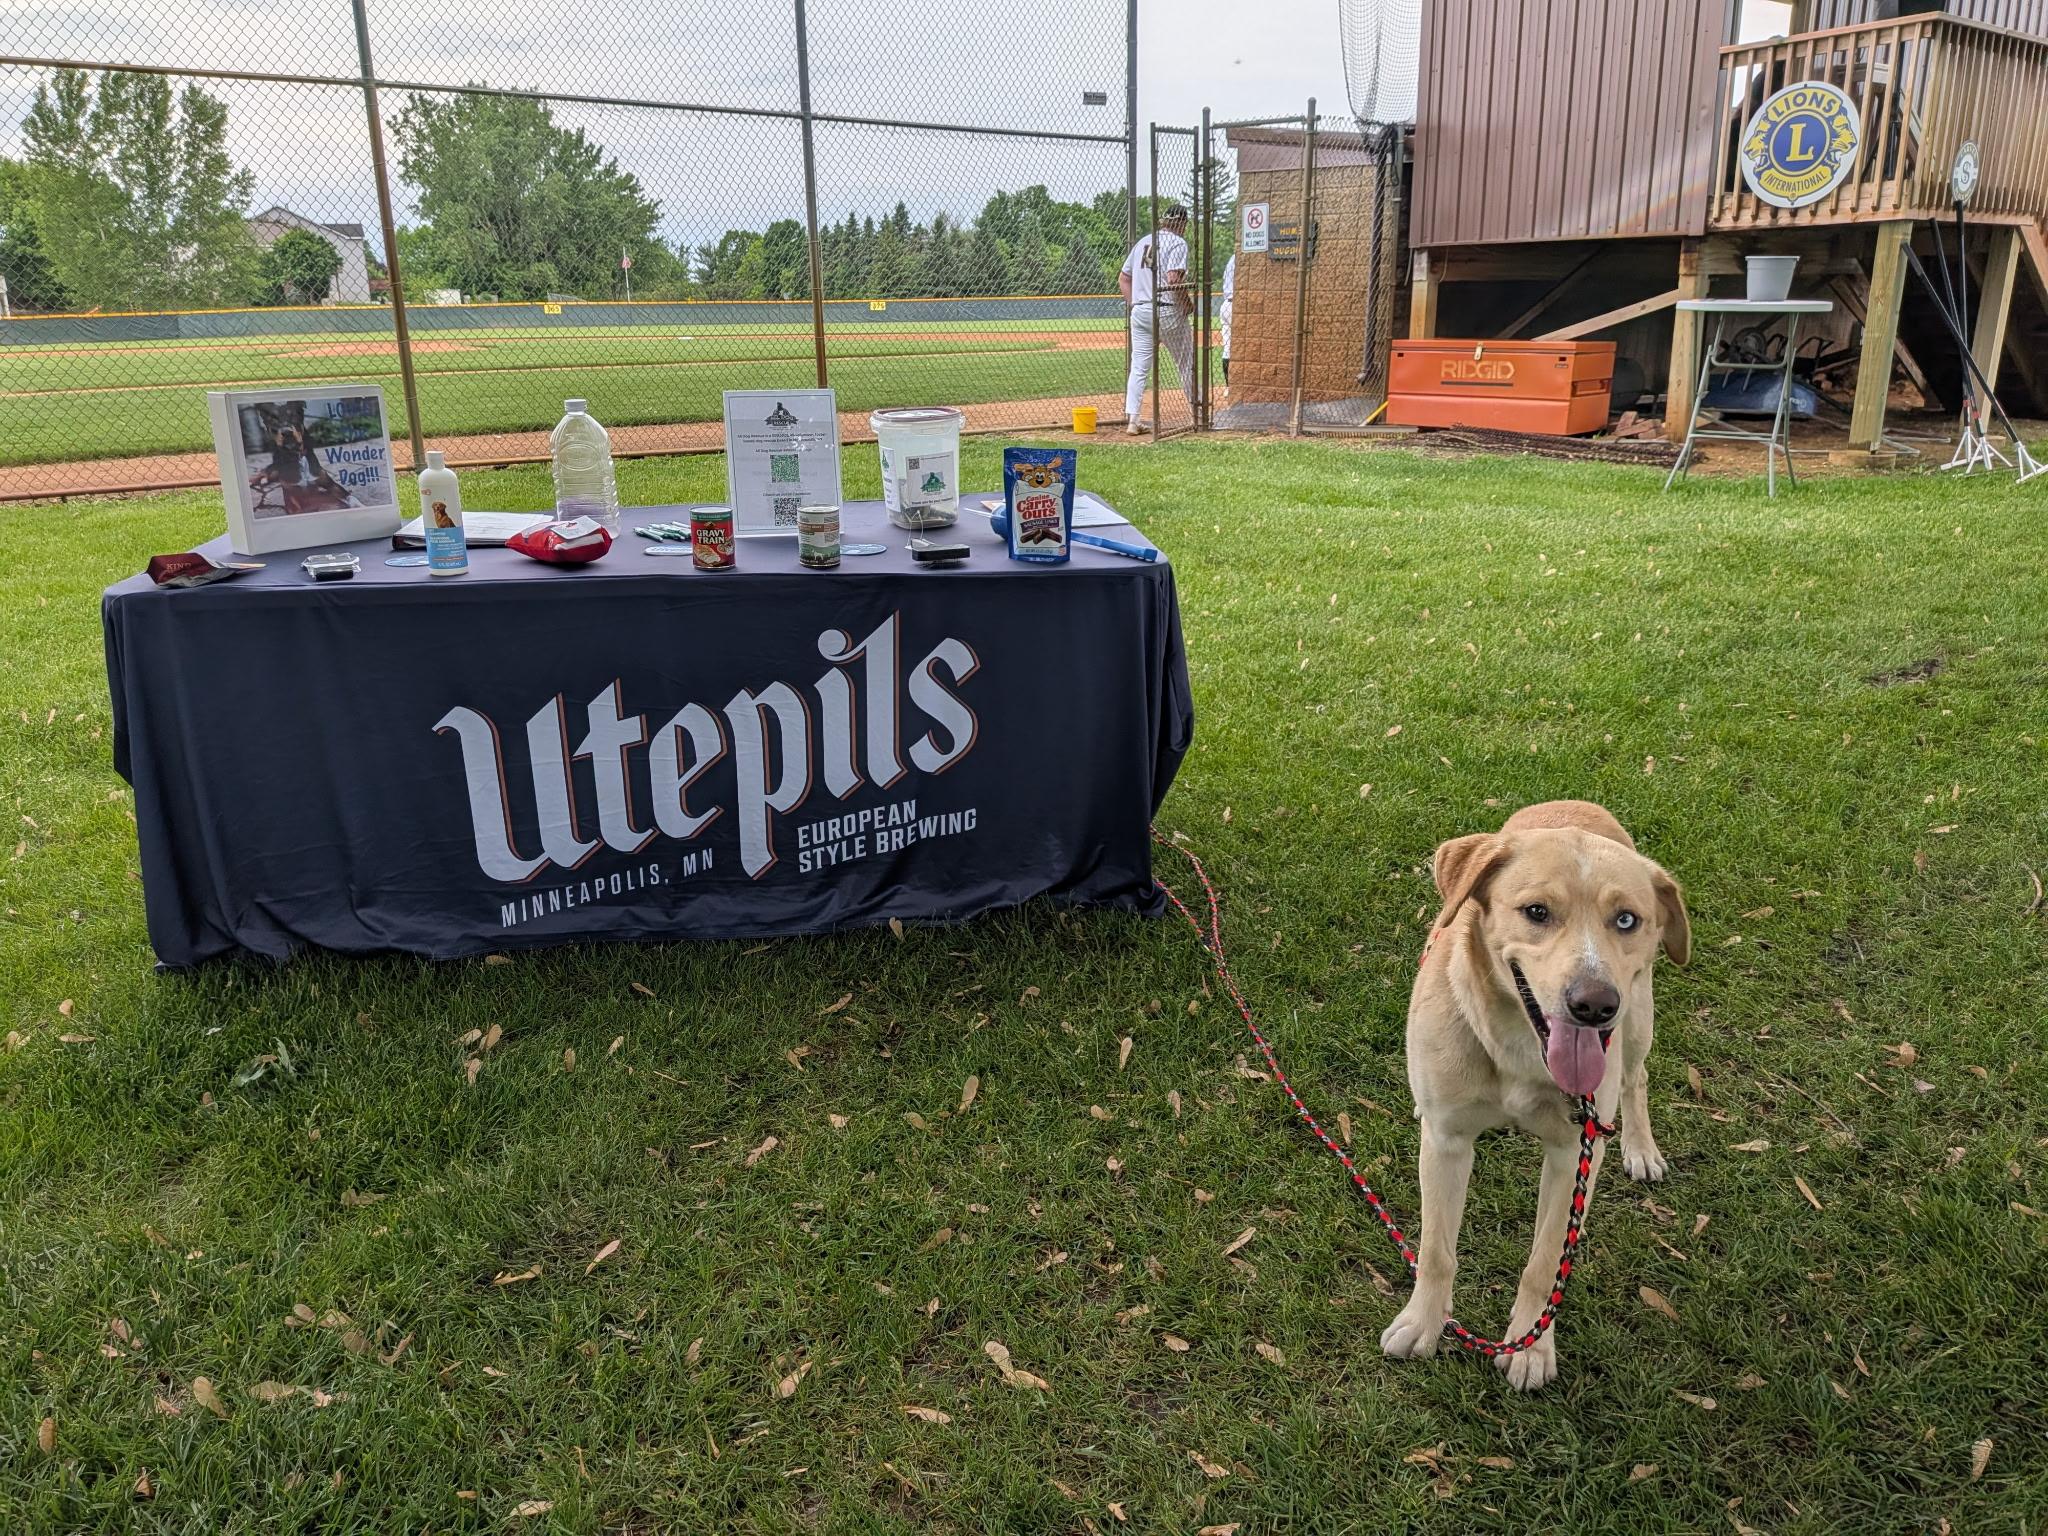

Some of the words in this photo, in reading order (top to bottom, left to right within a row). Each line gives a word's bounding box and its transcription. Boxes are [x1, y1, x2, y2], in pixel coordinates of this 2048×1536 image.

[1771, 91, 1837, 118] LIONS
[1785, 123, 1814, 162] L
[1763, 171, 1828, 193] INTERNATIONAL
[1960, 160, 1972, 184] S
[1245, 239, 1265, 248] ALLOWED
[1252, 230, 1265, 238] DOGS
[1440, 359, 1515, 380] RIDGID
[325, 445, 385, 465] Wonder
[338, 466, 380, 487] Dog!!!
[1016, 498, 1057, 513] Carry
[1025, 494, 1050, 502] Canine
[696, 529, 725, 537] GRAVY
[697, 536, 725, 544] TRAIN
[431, 610, 982, 881] Utepils
[797, 799, 917, 849] EUROPEAN
[798, 835, 867, 874] STYLE
[875, 807, 977, 854] BREWING
[500, 863, 669, 928] MINNEAPOLIS,
[683, 847, 714, 878] MN
